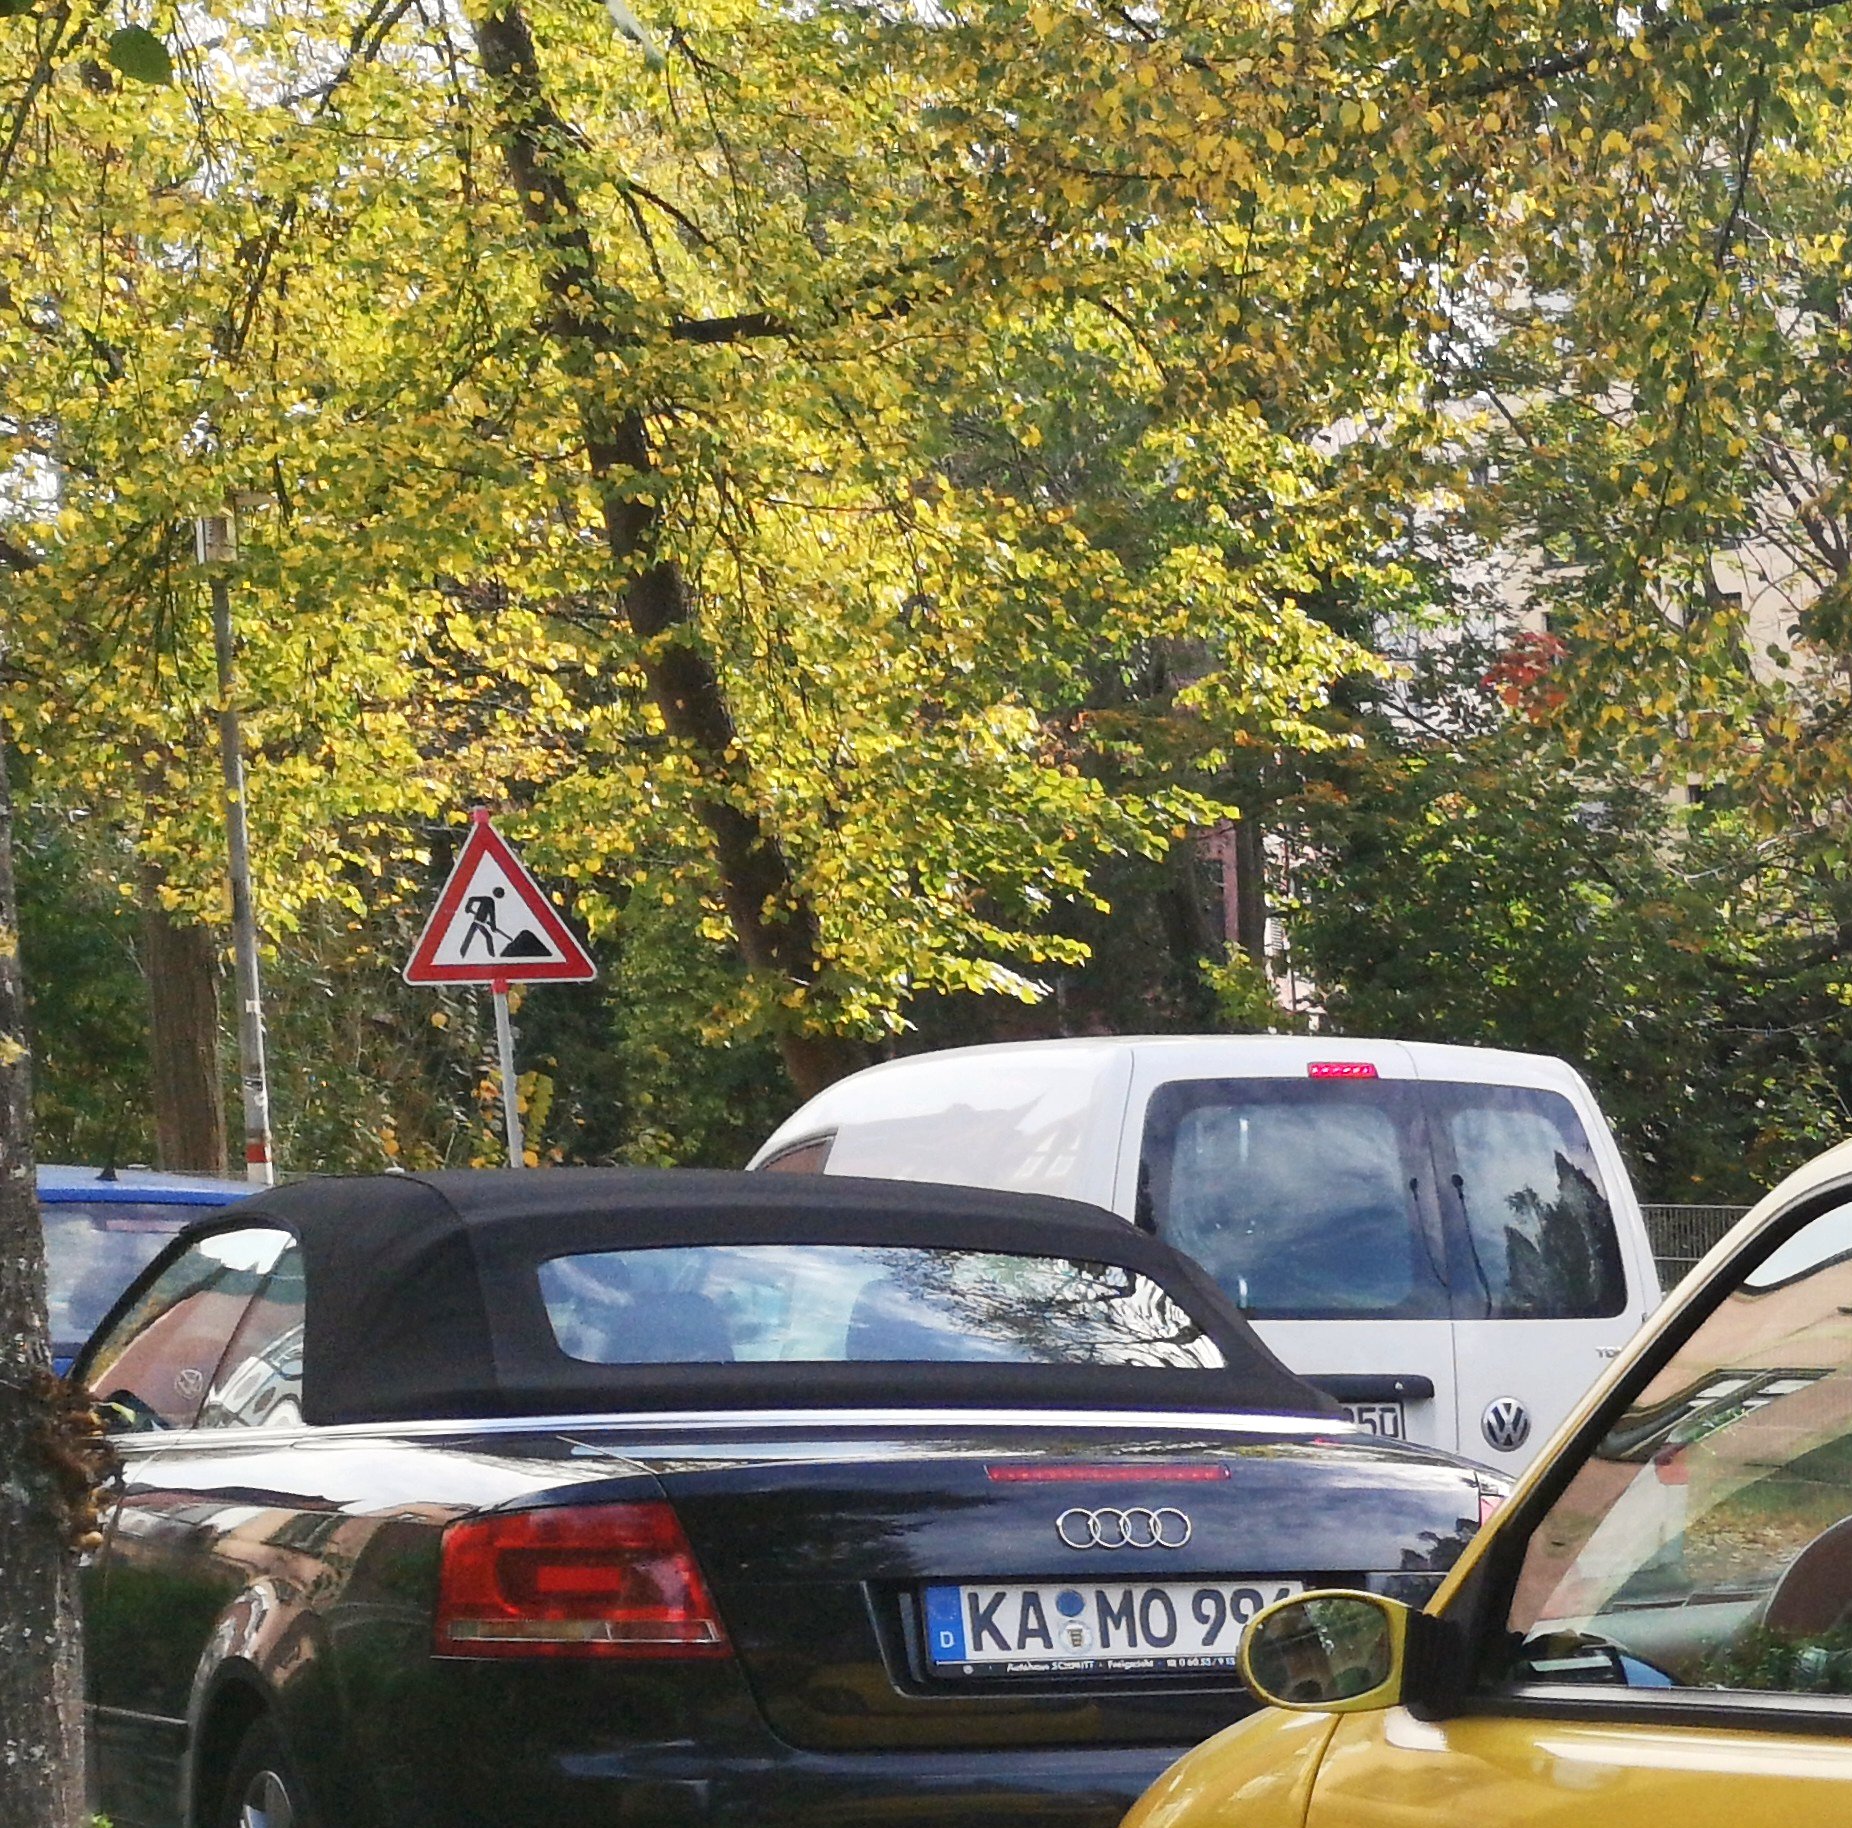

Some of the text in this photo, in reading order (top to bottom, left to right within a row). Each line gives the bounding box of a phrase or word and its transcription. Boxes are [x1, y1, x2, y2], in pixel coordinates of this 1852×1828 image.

[939, 1630, 955, 1648] D
[967, 1587, 1291, 1652] KA MO 99
